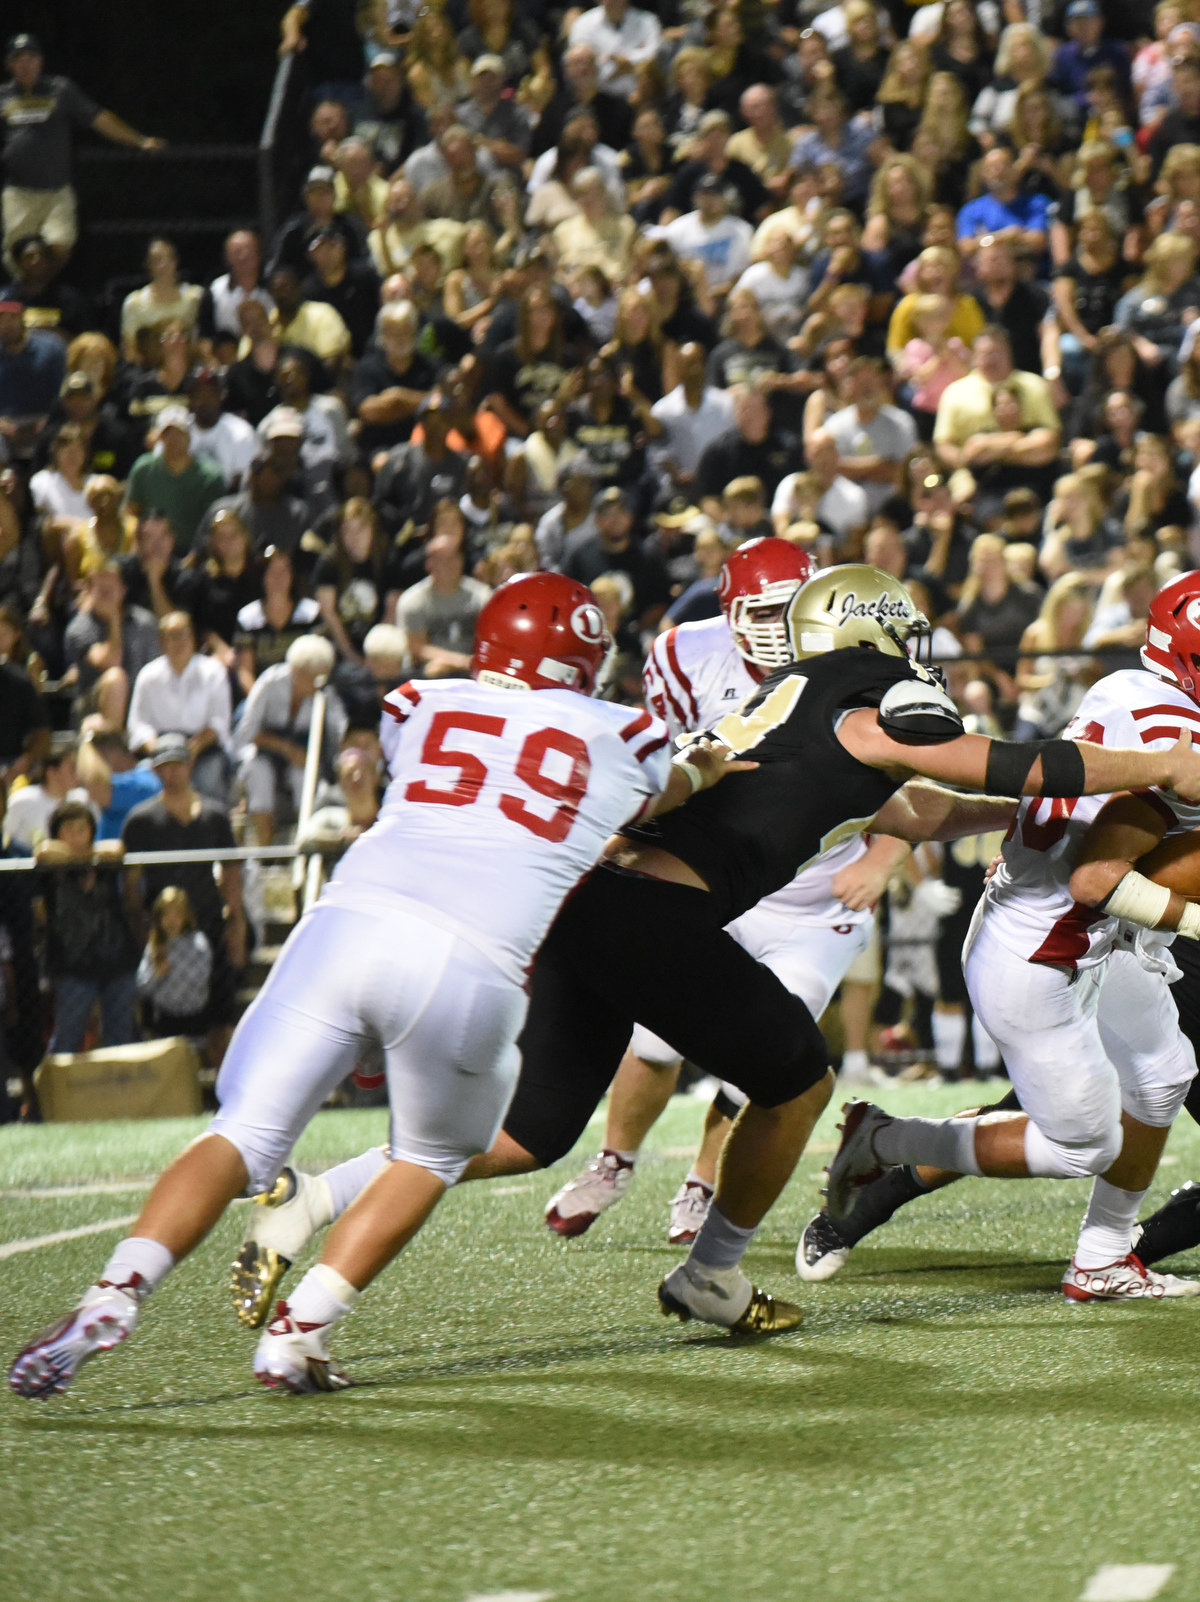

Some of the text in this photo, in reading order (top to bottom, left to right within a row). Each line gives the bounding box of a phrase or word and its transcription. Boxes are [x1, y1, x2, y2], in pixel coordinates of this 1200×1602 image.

[575, 606, 604, 641] D
[838, 592, 910, 627] Jackets
[404, 711, 591, 842] 59
[1074, 1271, 1165, 1298] adizero
